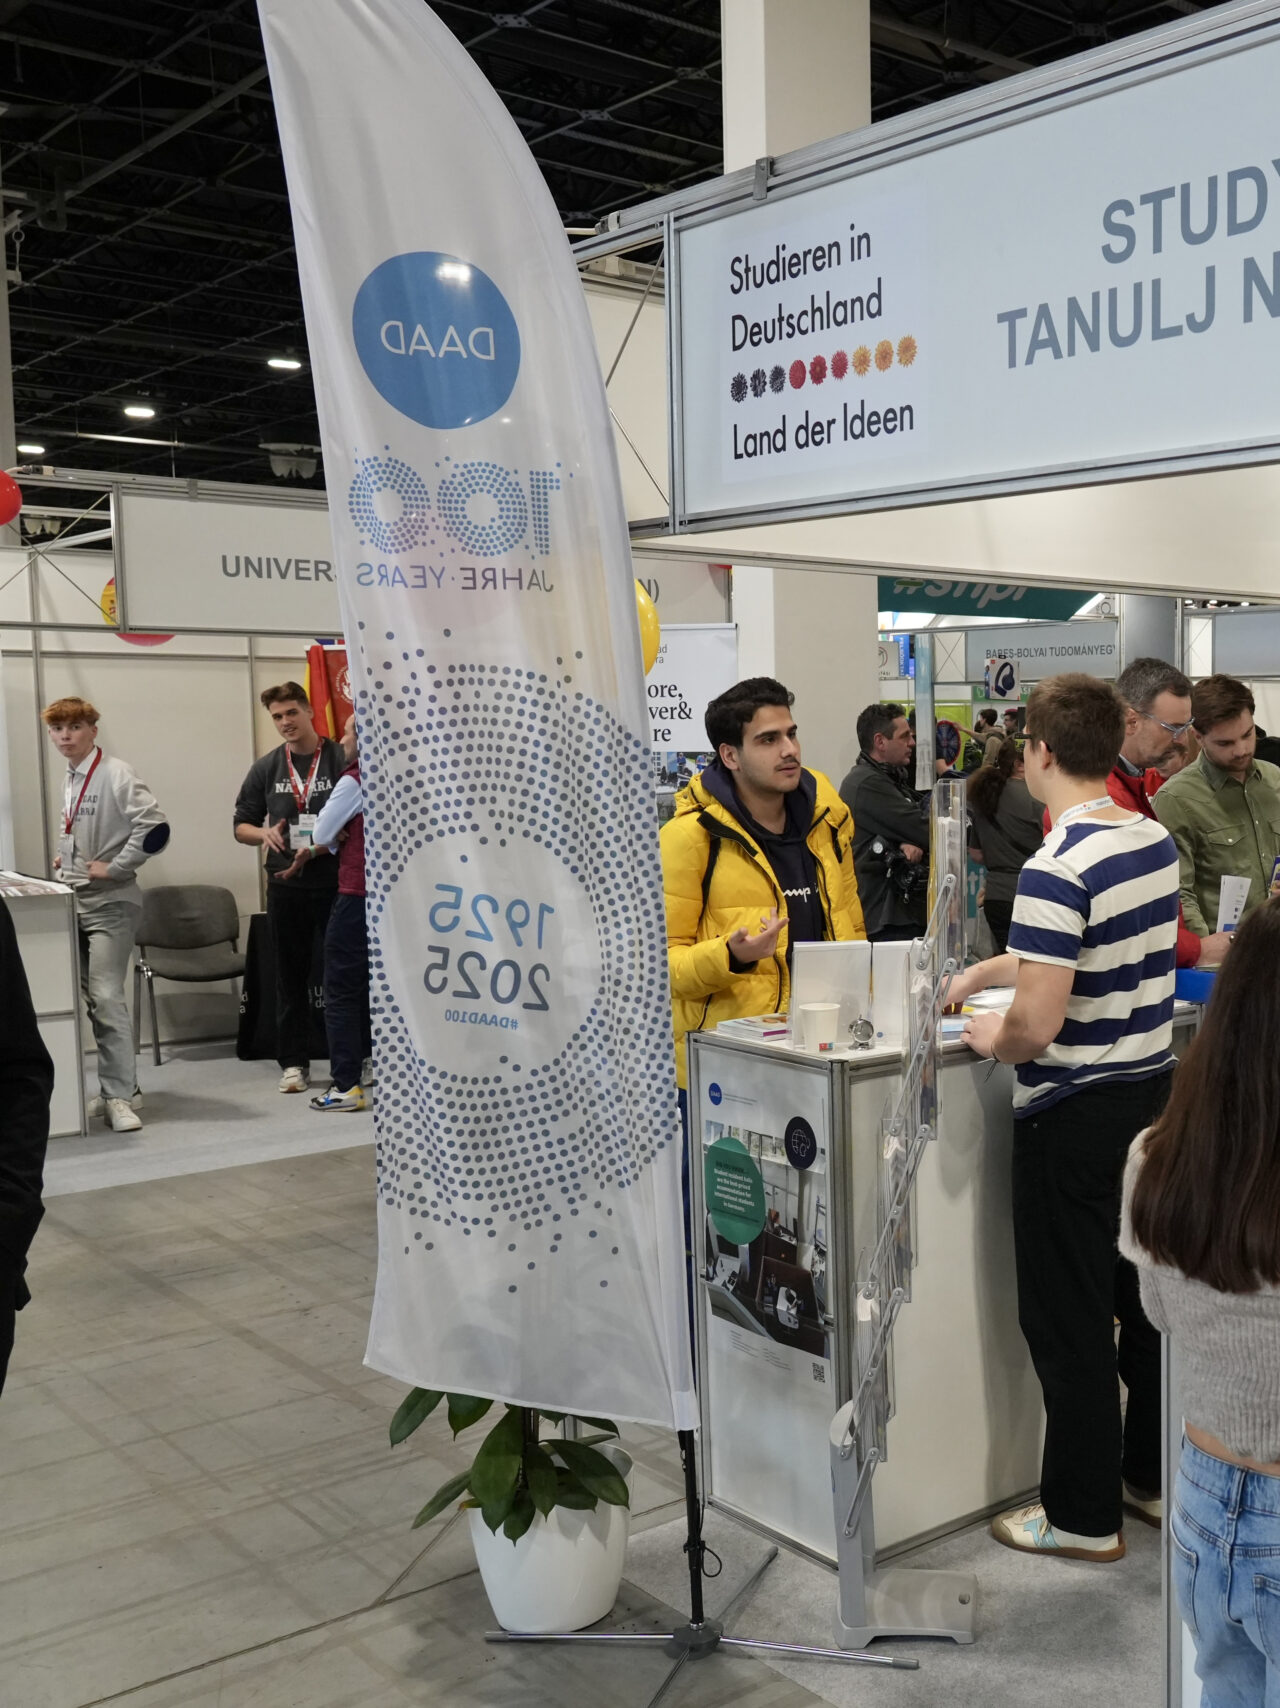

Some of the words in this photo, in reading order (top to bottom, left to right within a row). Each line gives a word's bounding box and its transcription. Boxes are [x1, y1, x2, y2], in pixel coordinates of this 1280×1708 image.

[730, 244, 841, 295] Studieren
[850, 223, 871, 262] in
[731, 277, 882, 352] Deutschland
[997, 265, 1217, 369] TANULJ
[733, 414, 786, 460] Land
[795, 410, 836, 450] der
[843, 399, 914, 441] Ideen
[221, 554, 337, 582] UNIVER
[647, 684, 683, 701] ore,
[649, 701, 693, 720] ver&
[653, 728, 671, 742] re
